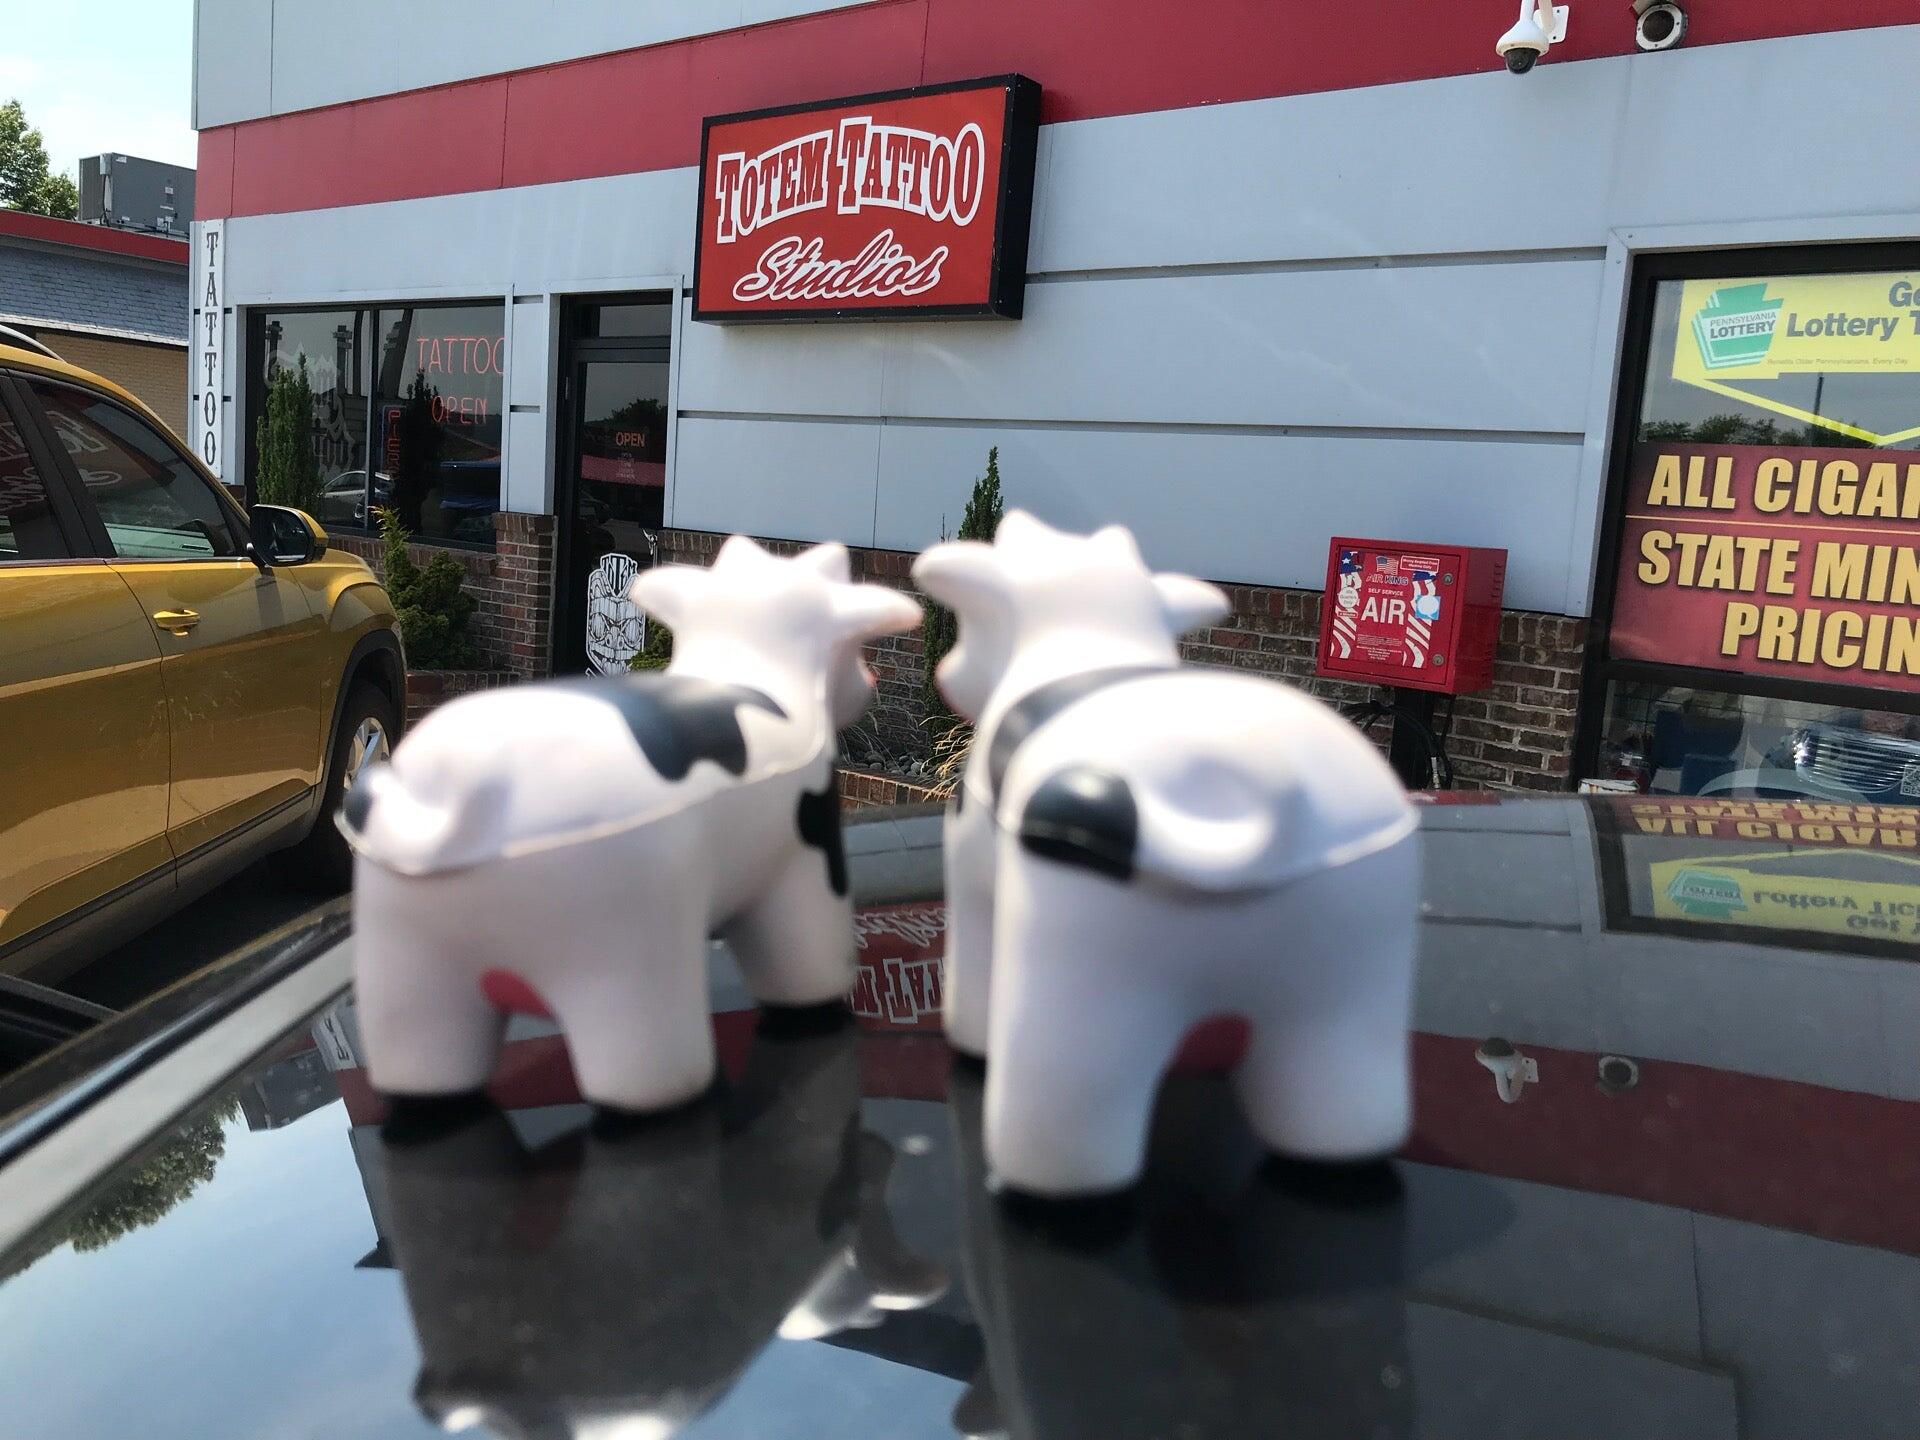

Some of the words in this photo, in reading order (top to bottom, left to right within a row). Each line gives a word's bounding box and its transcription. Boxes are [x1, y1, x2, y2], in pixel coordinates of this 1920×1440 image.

[716, 129, 834, 244] TOTEM
[837, 115, 985, 227] TATTOO
[732, 228, 949, 302] Studios
[1710, 311, 1777, 327] PENNSYLVANIA
[1710, 320, 1775, 339] LOTTERY
[1786, 312, 1900, 341] Lottery
[204, 231, 219, 466] TATTOO
[417, 336, 505, 374] TATTOO
[432, 395, 487, 425] OPEN
[615, 431, 646, 447] OPEN
[1646, 455, 1736, 509] ALL
[1366, 573, 1384, 583] AIR
[1385, 576, 1409, 585] KING
[1638, 530, 1800, 595] STATE
[1360, 596, 1406, 625] AIR
[1721, 602, 1920, 675] PRICIN
